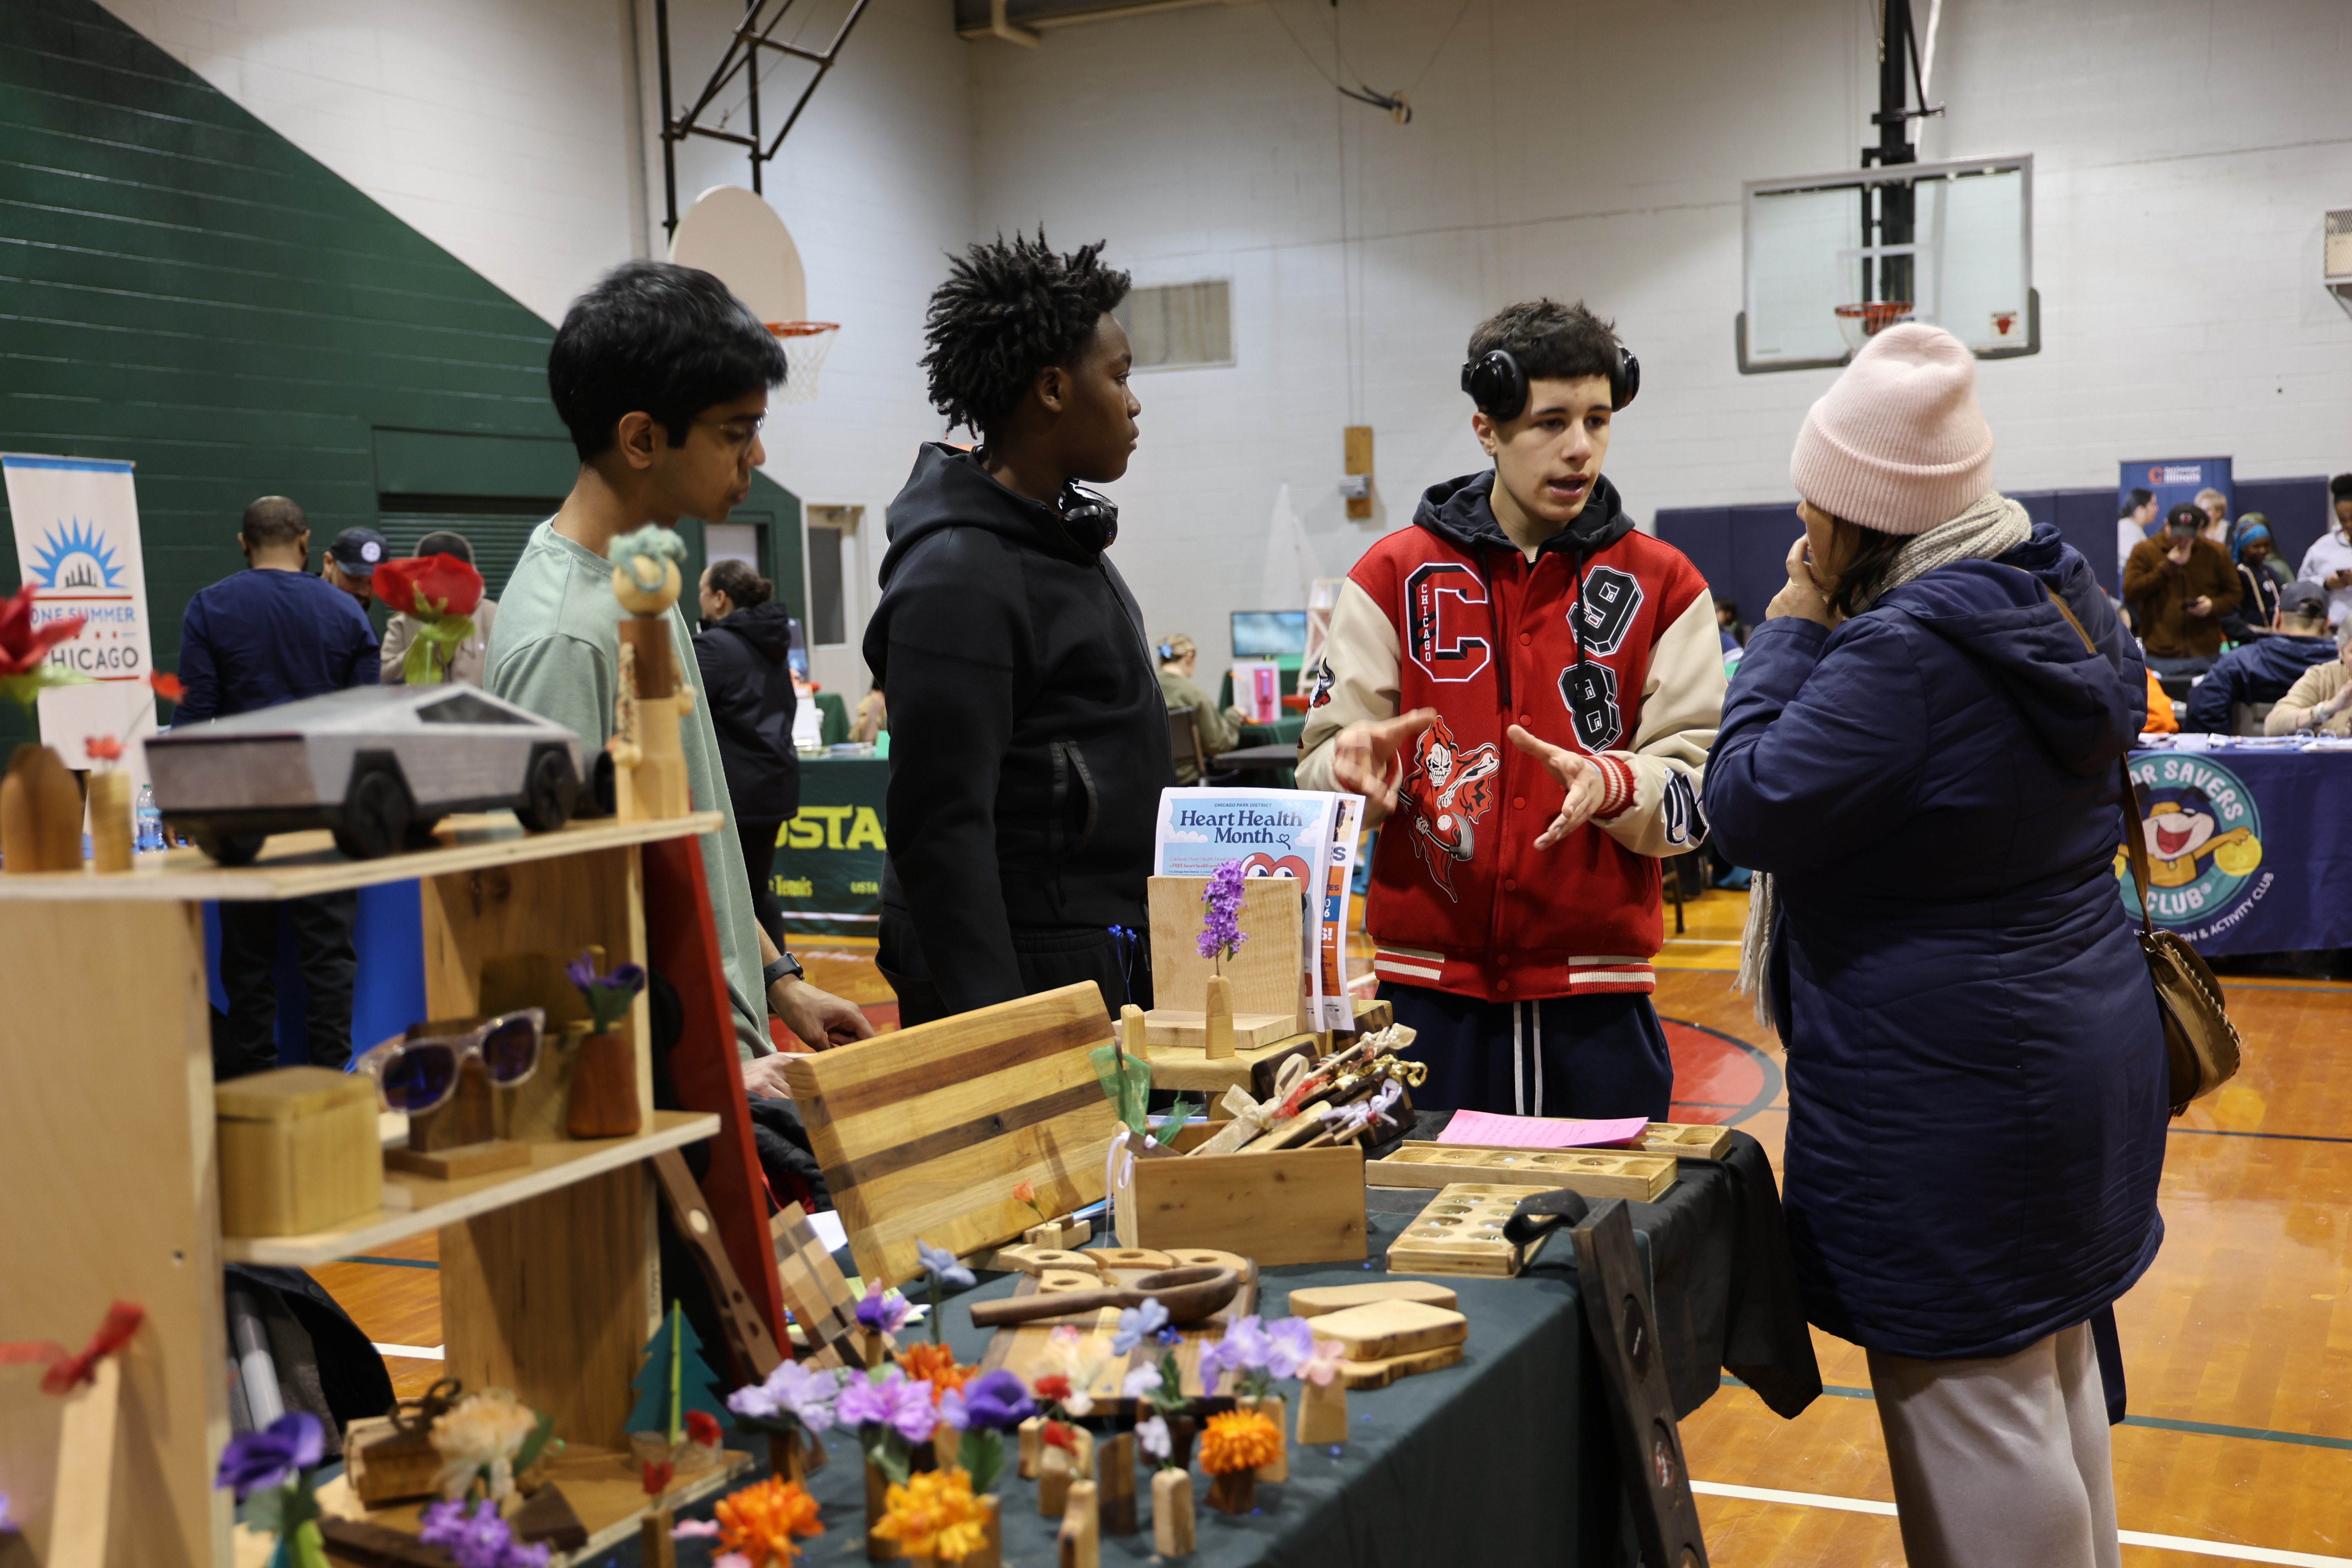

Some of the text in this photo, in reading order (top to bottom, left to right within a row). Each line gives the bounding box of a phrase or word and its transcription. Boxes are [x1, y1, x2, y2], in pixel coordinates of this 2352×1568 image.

[1405, 563, 1490, 682] C
[1421, 584, 1431, 662] CHICAGO
[1566, 565, 1644, 657] 9
[51, 647, 138, 670] HICAGO
[1557, 660, 1623, 754] 8
[1180, 810, 1303, 826] Heart Health
[2163, 759, 2244, 820] SAVERS
[1214, 827, 1274, 844] Month
[2210, 898, 2254, 936] ACTIVITY
[2252, 872, 2274, 900] CLUB
